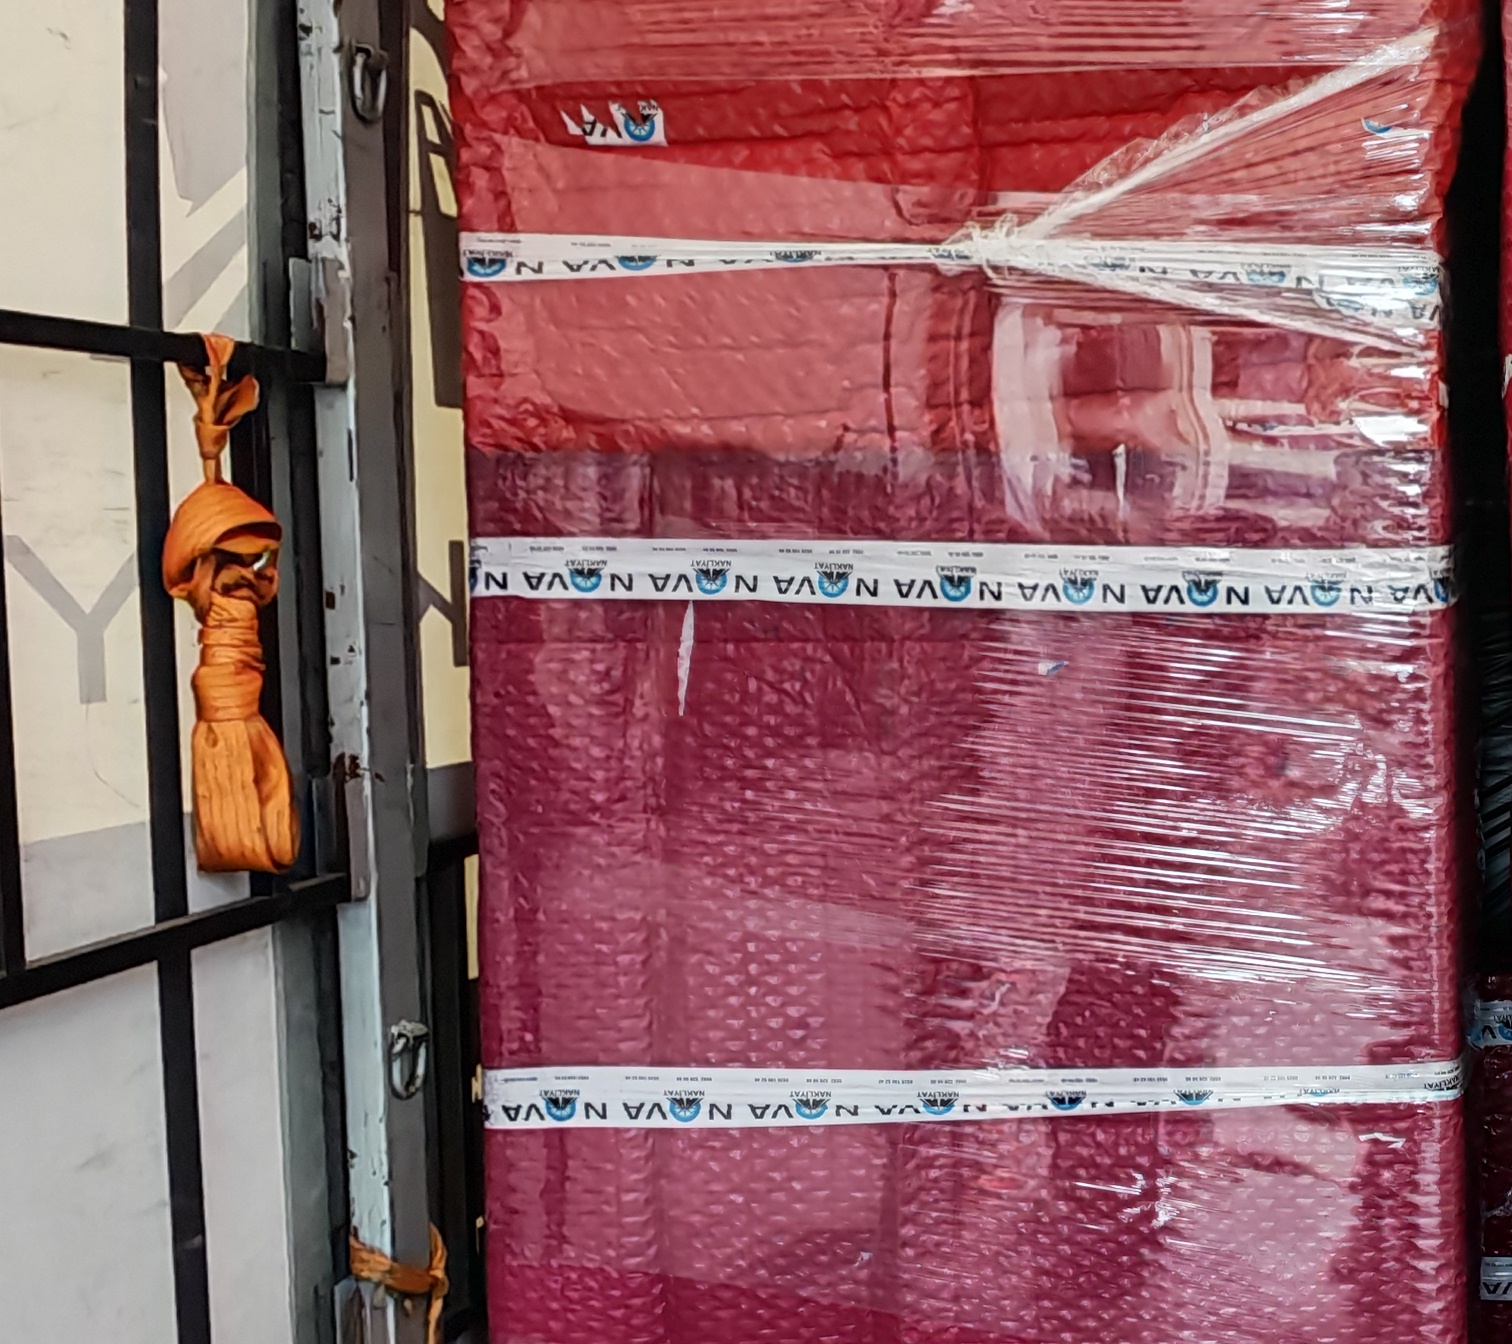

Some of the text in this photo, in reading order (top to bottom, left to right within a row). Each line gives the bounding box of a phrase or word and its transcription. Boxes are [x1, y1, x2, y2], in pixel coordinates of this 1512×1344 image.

[522, 569, 634, 593] NOVA
[650, 571, 758, 595] NOVA
[773, 574, 879, 598] NOVA
[501, 1101, 608, 1122] NOVA
[622, 1100, 732, 1122] NOVA
[748, 1102, 859, 1119] NOVA
